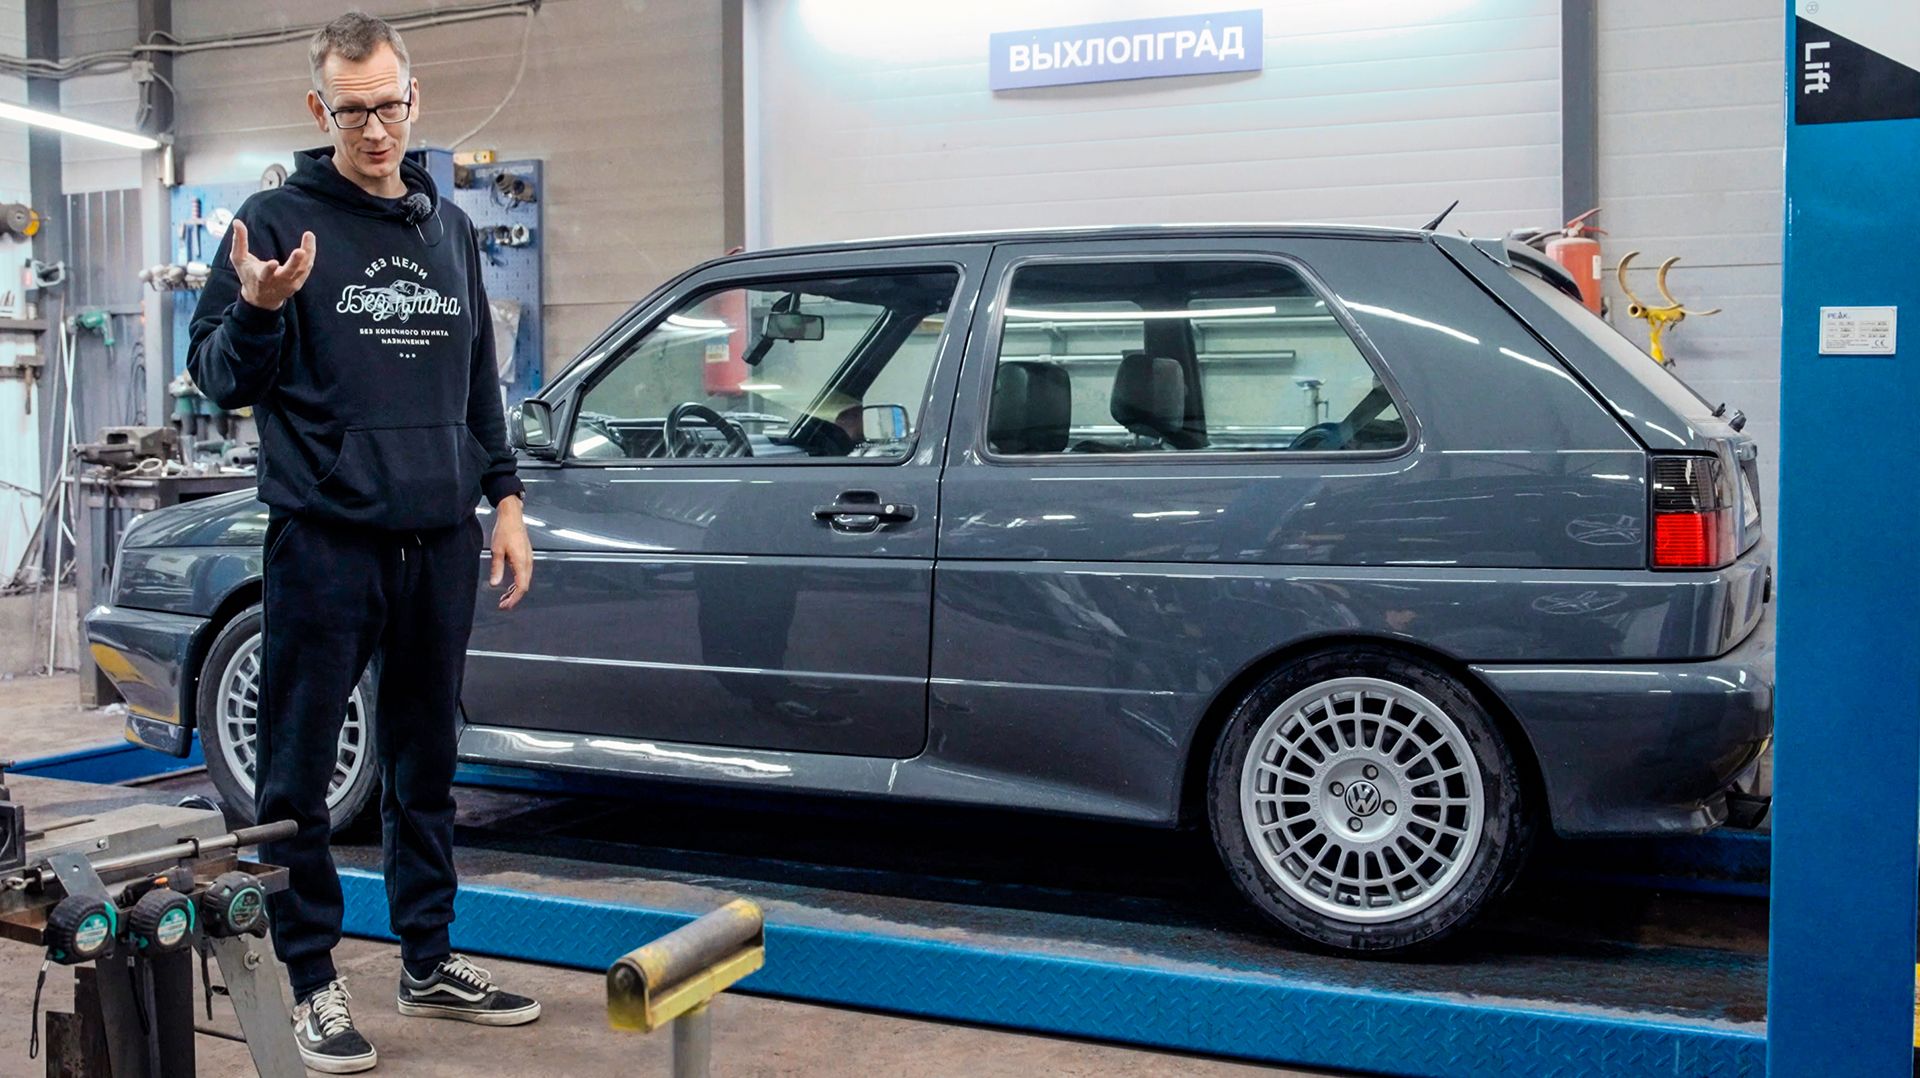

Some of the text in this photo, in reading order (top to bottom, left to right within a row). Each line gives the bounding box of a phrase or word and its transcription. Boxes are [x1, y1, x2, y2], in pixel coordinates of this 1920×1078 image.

[1009, 26, 1245, 73] ВЫХЛОПГРАД
[1804, 41, 1831, 94] Lift
[365, 256, 428, 280] БЕЗ ЦЕЛИ
[336, 284, 461, 321] Без плана
[375, 328, 419, 336] КОНЕЧНОГО
